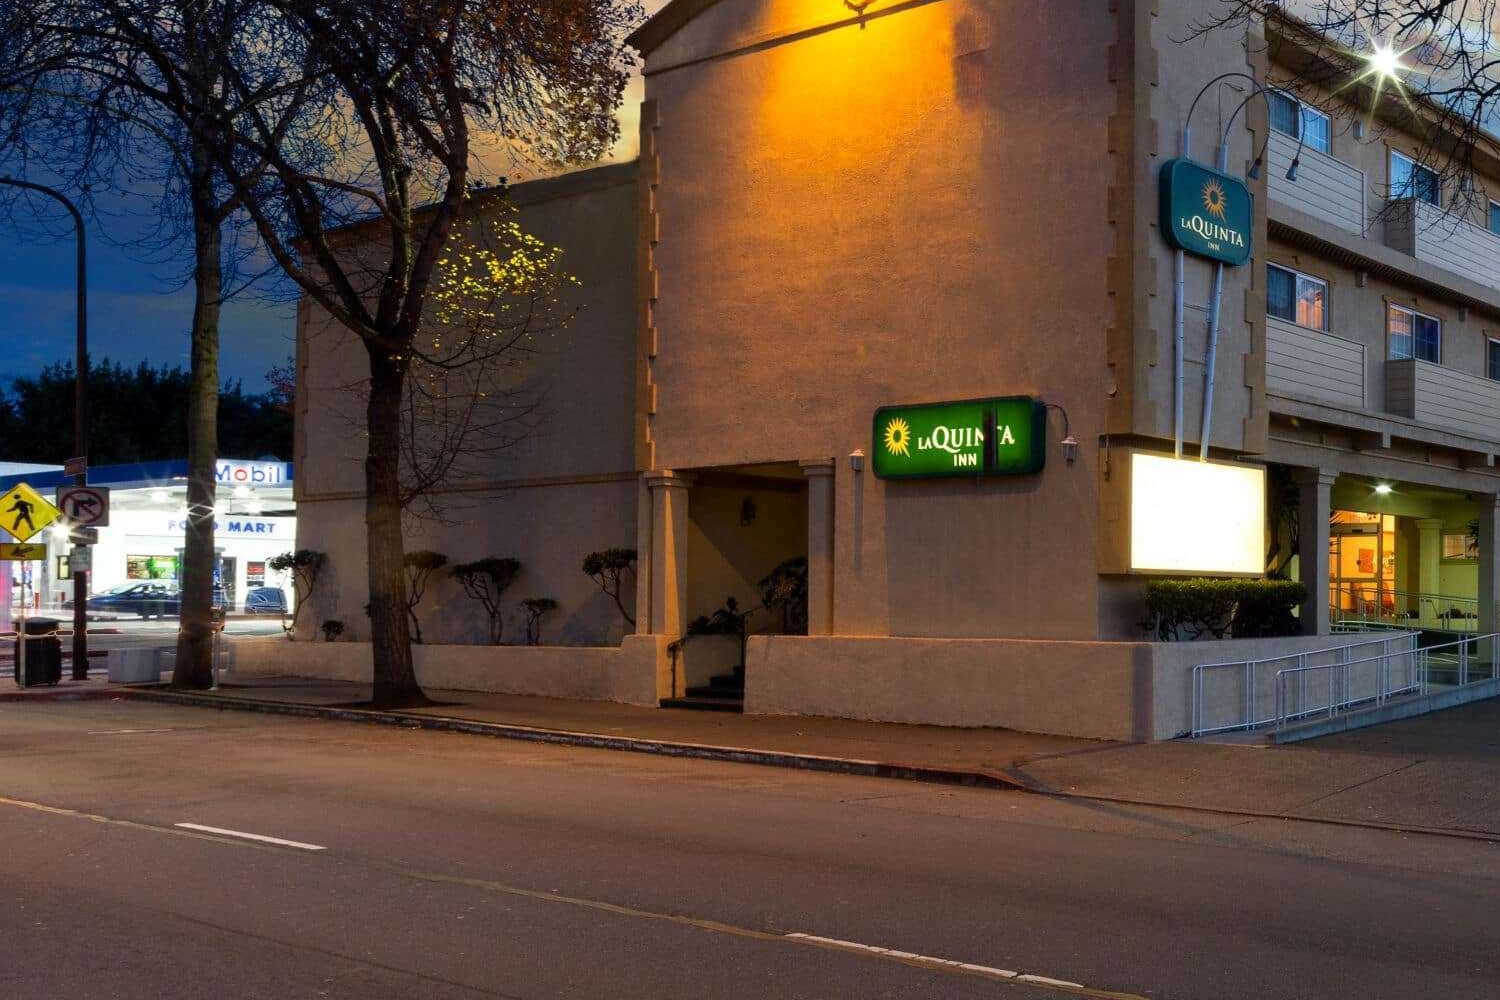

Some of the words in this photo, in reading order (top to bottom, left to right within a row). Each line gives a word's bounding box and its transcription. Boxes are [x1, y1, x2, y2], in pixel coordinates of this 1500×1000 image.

[932, 425, 1015, 453] QUINA
[954, 453, 977, 467] INN
[215, 465, 280, 483] Mobil
[168, 519, 219, 531] FOD
[228, 521, 276, 533] MART
